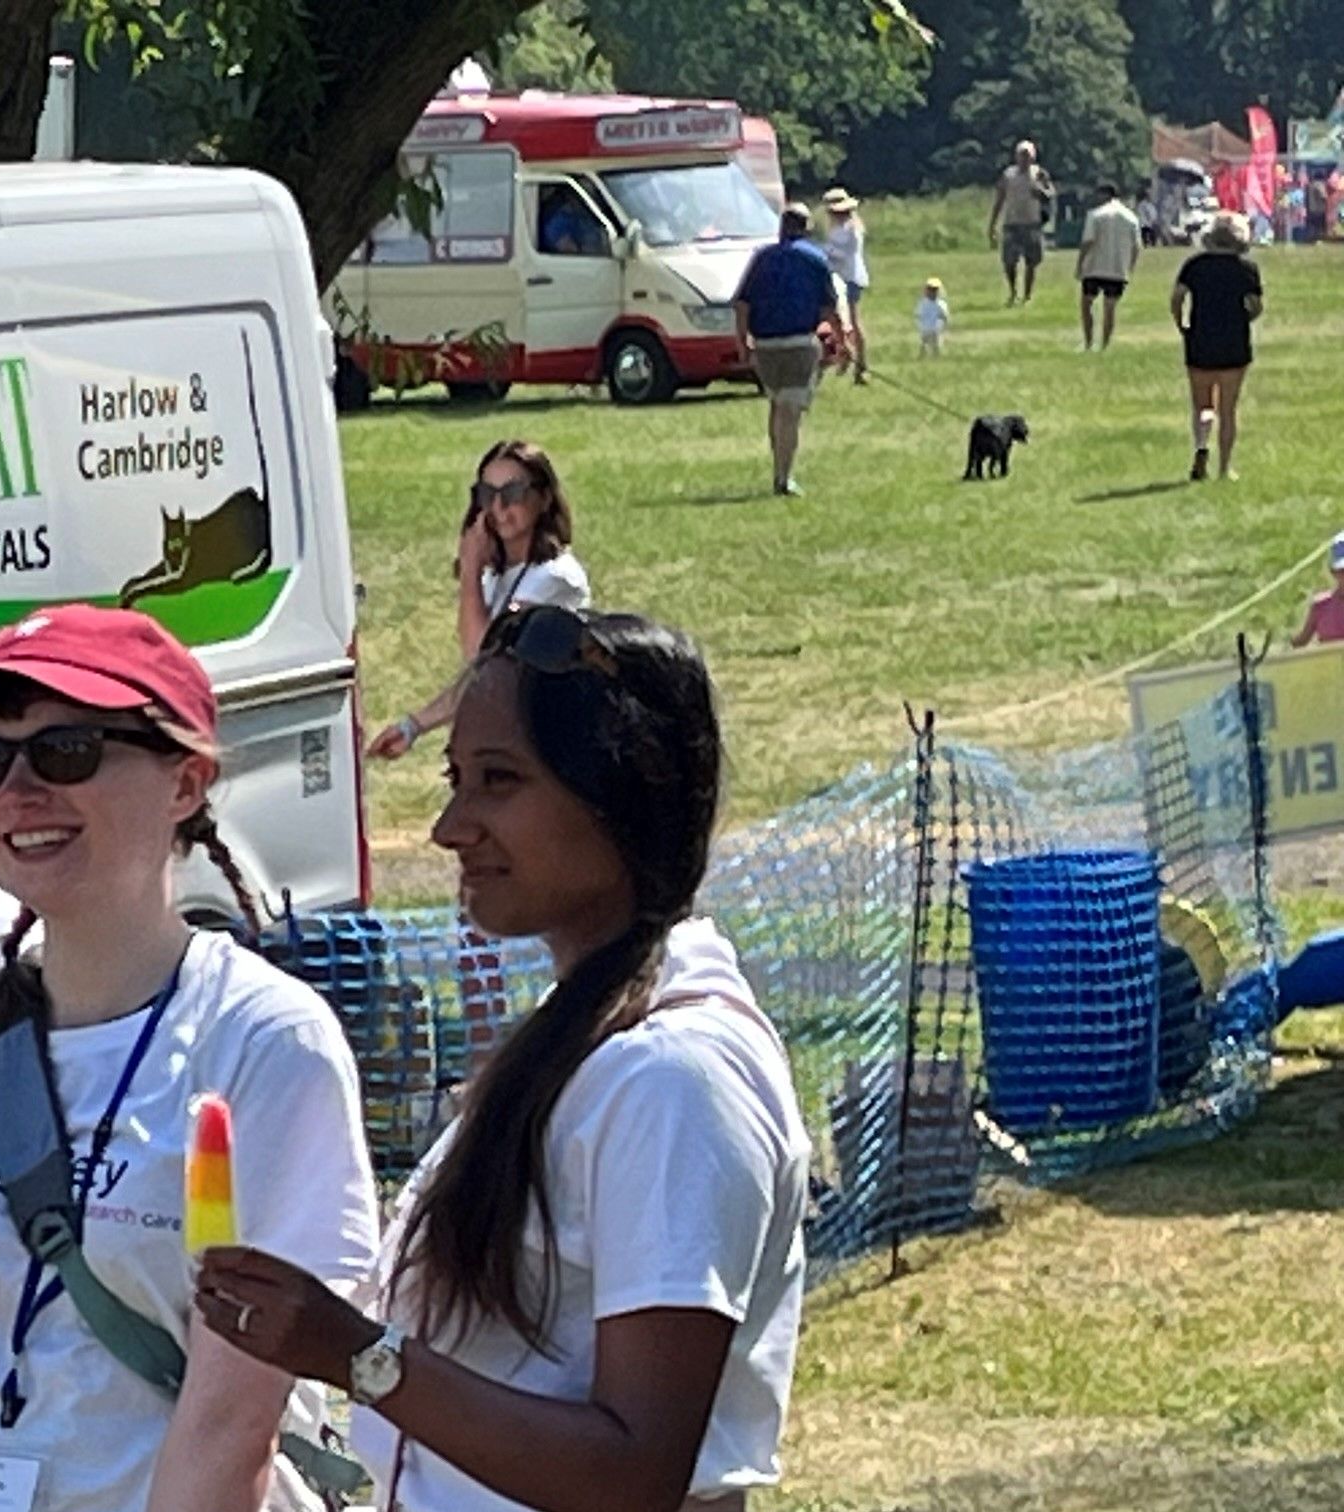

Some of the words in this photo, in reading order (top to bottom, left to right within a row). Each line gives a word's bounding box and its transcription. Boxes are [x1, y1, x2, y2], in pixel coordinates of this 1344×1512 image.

[79, 375, 179, 424] Harlow
[189, 372, 207, 412] &
[78, 426, 224, 481] Cambridge
